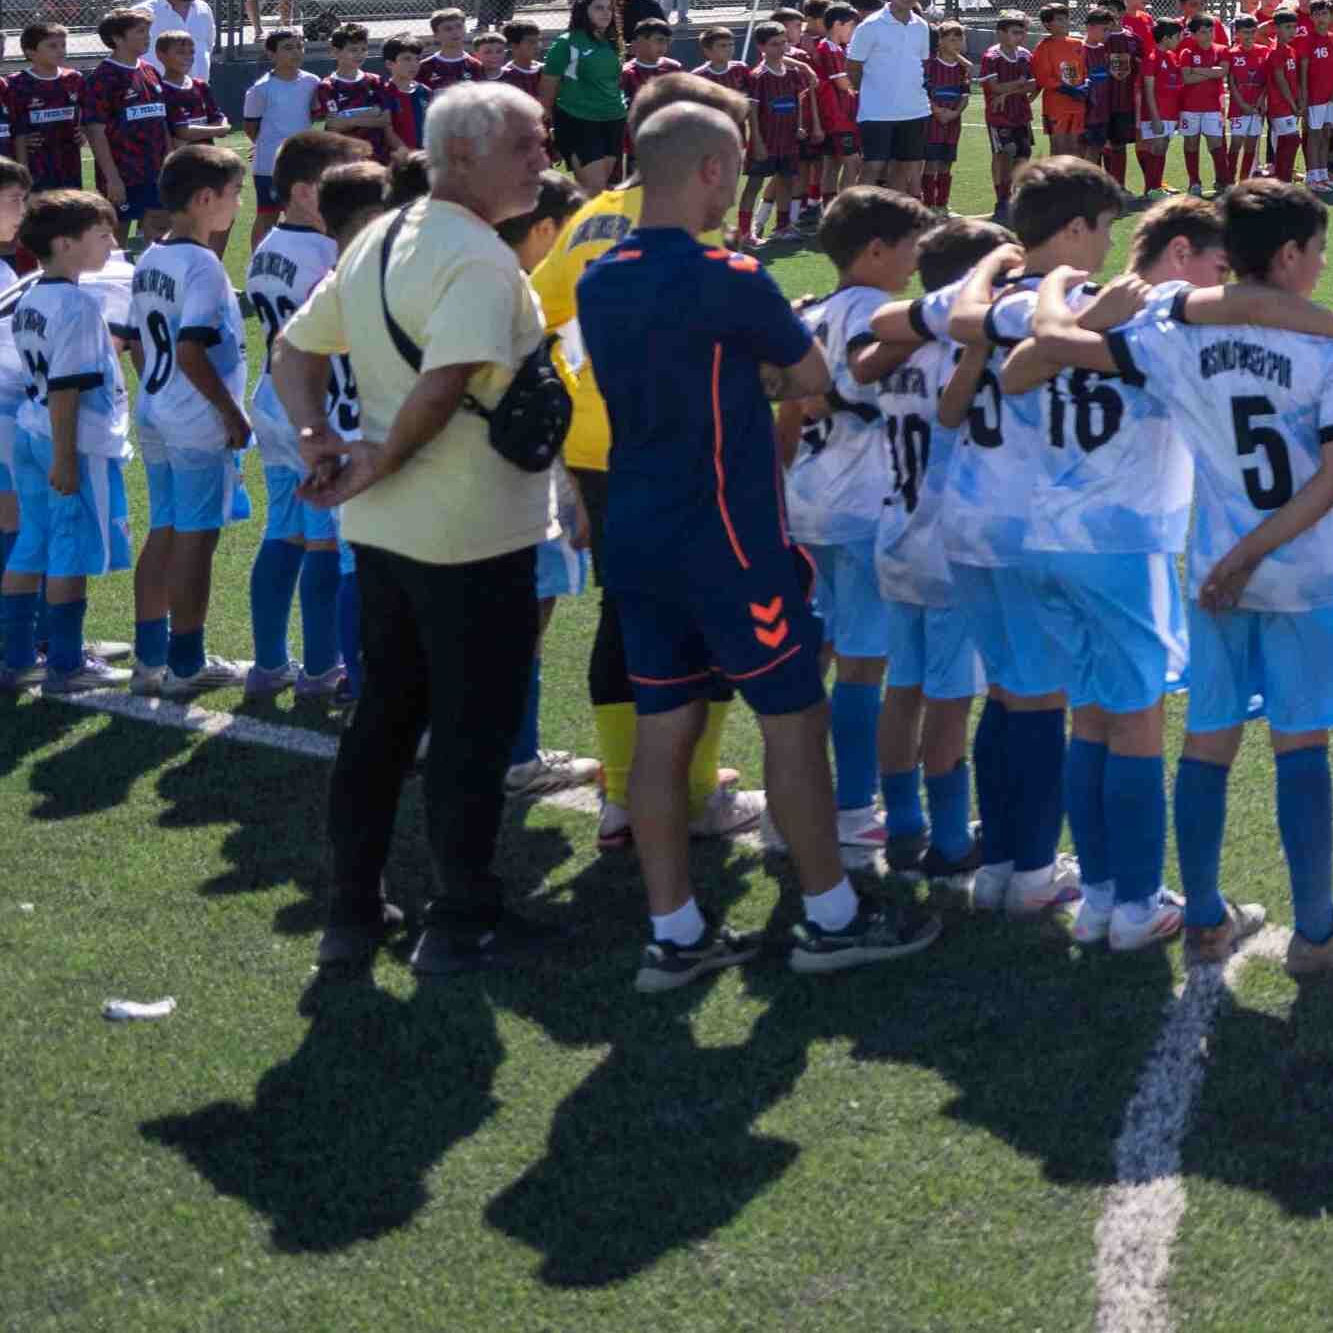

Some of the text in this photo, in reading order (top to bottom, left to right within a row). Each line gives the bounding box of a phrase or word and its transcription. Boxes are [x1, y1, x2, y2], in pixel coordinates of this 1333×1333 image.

[1313, 47, 1329, 58] 16
[1233, 56, 1247, 66] 25
[1231, 395, 1294, 511] 5
